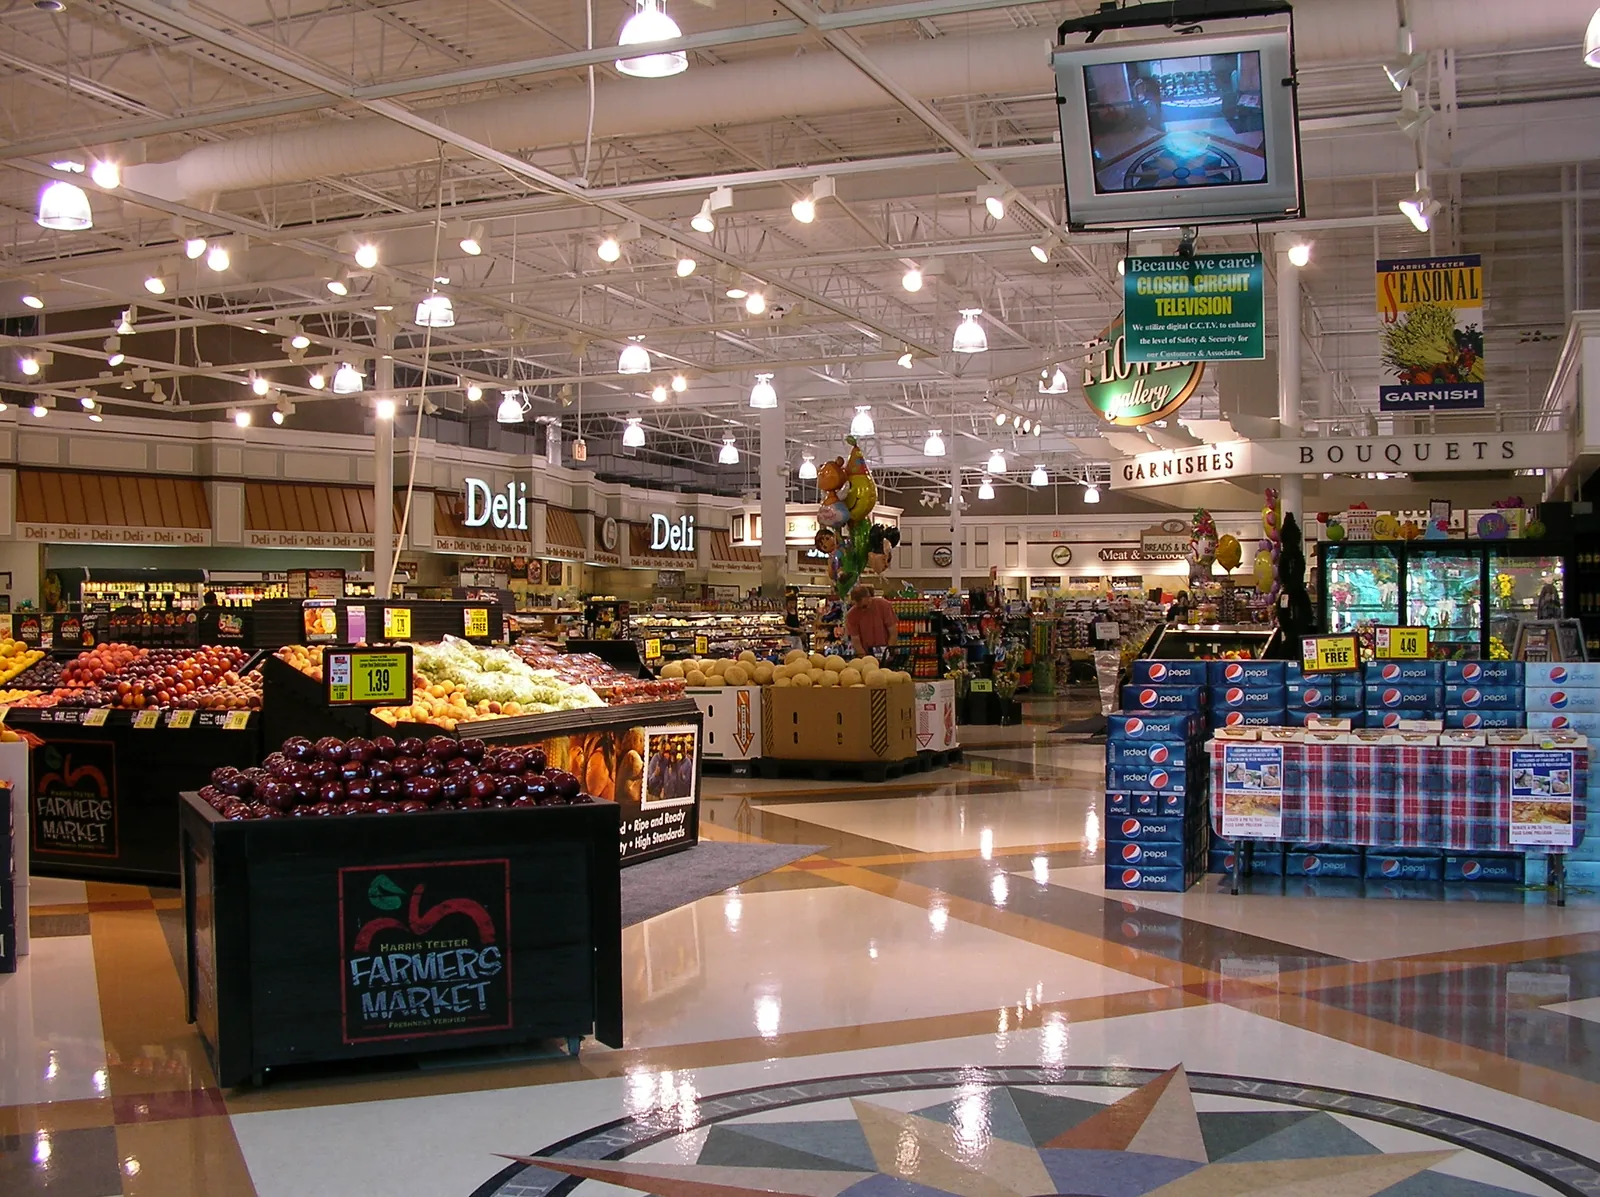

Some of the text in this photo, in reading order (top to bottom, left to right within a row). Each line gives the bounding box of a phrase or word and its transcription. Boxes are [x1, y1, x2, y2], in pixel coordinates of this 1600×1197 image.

[1131, 254, 1255, 272] Because we care!
[1392, 261, 1465, 271] HARRIS TEETER
[1136, 273, 1250, 295] CLOSED CIRCUIT
[1383, 268, 1478, 323] SEASONAL
[1155, 296, 1232, 317] TELEVISION
[1132, 323, 1143, 331] We
[1145, 323, 1165, 331] utilize
[1166, 322, 1188, 332] digital
[1189, 322, 1218, 330] C.C.T.V.
[1139, 337, 1151, 345] the
[1152, 337, 1167, 345] level
[1177, 336, 1197, 345] Safety
[1208, 335, 1236, 344] Security
[1238, 334, 1249, 342] for
[1159, 350, 1196, 358] Customers
[1205, 349, 1242, 357] Associates.
[1105, 378, 1171, 421] gallery
[1385, 390, 1478, 402] GARNISH
[1299, 440, 1515, 466] BOUQUETS
[1123, 452, 1234, 481] GARNISHES
[464, 477, 528, 530] Deli
[25, 527, 204, 543] Deli Deli Deli Deli Deli Deli
[650, 513, 695, 552] Deli
[251, 534, 270, 544] Deli
[279, 535, 298, 545] Deli
[306, 536, 325, 546] Deli
[333, 536, 350, 546] Deli
[358, 537, 375, 547] Deli
[437, 539, 527, 553] Deli Deli Deli Deli Deli Deli
[1144, 543, 1172, 552] BREADS
[1102, 549, 1128, 560] Meat
[1130, 549, 1141, 560] &
[1400, 638, 1417, 653] 4.49
[1325, 651, 1349, 664] FREE
[1168, 668, 1191, 677] pepsi
[1244, 669, 1268, 678] pepsi
[1403, 669, 1427, 677] pepsi
[1483, 668, 1507, 677] pepsi
[367, 668, 390, 692] 1.39
[1159, 694, 1182, 703] pepsi
[1245, 692, 1268, 702] pepsi
[1403, 693, 1427, 703] pepsi
[1483, 693, 1507, 703] pepsi
[1245, 716, 1268, 725] pepsi
[1483, 718, 1508, 727] pepsi
[1145, 723, 1170, 733] pepsi
[1123, 749, 1147, 757] pepsi
[1123, 774, 1147, 783] pepsi
[36, 797, 113, 821] FARMERS
[634, 817, 649, 833] Ripe
[650, 812, 664, 827] and
[664, 808, 686, 824] Ready
[42, 821, 107, 843] MARKET
[1143, 825, 1167, 833] pepsi
[634, 833, 651, 850] High
[652, 825, 685, 844] Standards
[1143, 850, 1168, 859] pepsi
[1323, 862, 1346, 870] pepsi
[1402, 864, 1426, 873] pepsi
[1482, 866, 1507, 875] pepsi
[1143, 875, 1167, 884] pepsi
[380, 938, 469, 952] HARRIS TEETER
[350, 946, 502, 986] FARMERS
[361, 981, 491, 1020] MARKET
[388, 1016, 466, 1029] FRESHNESS VERIFIED
